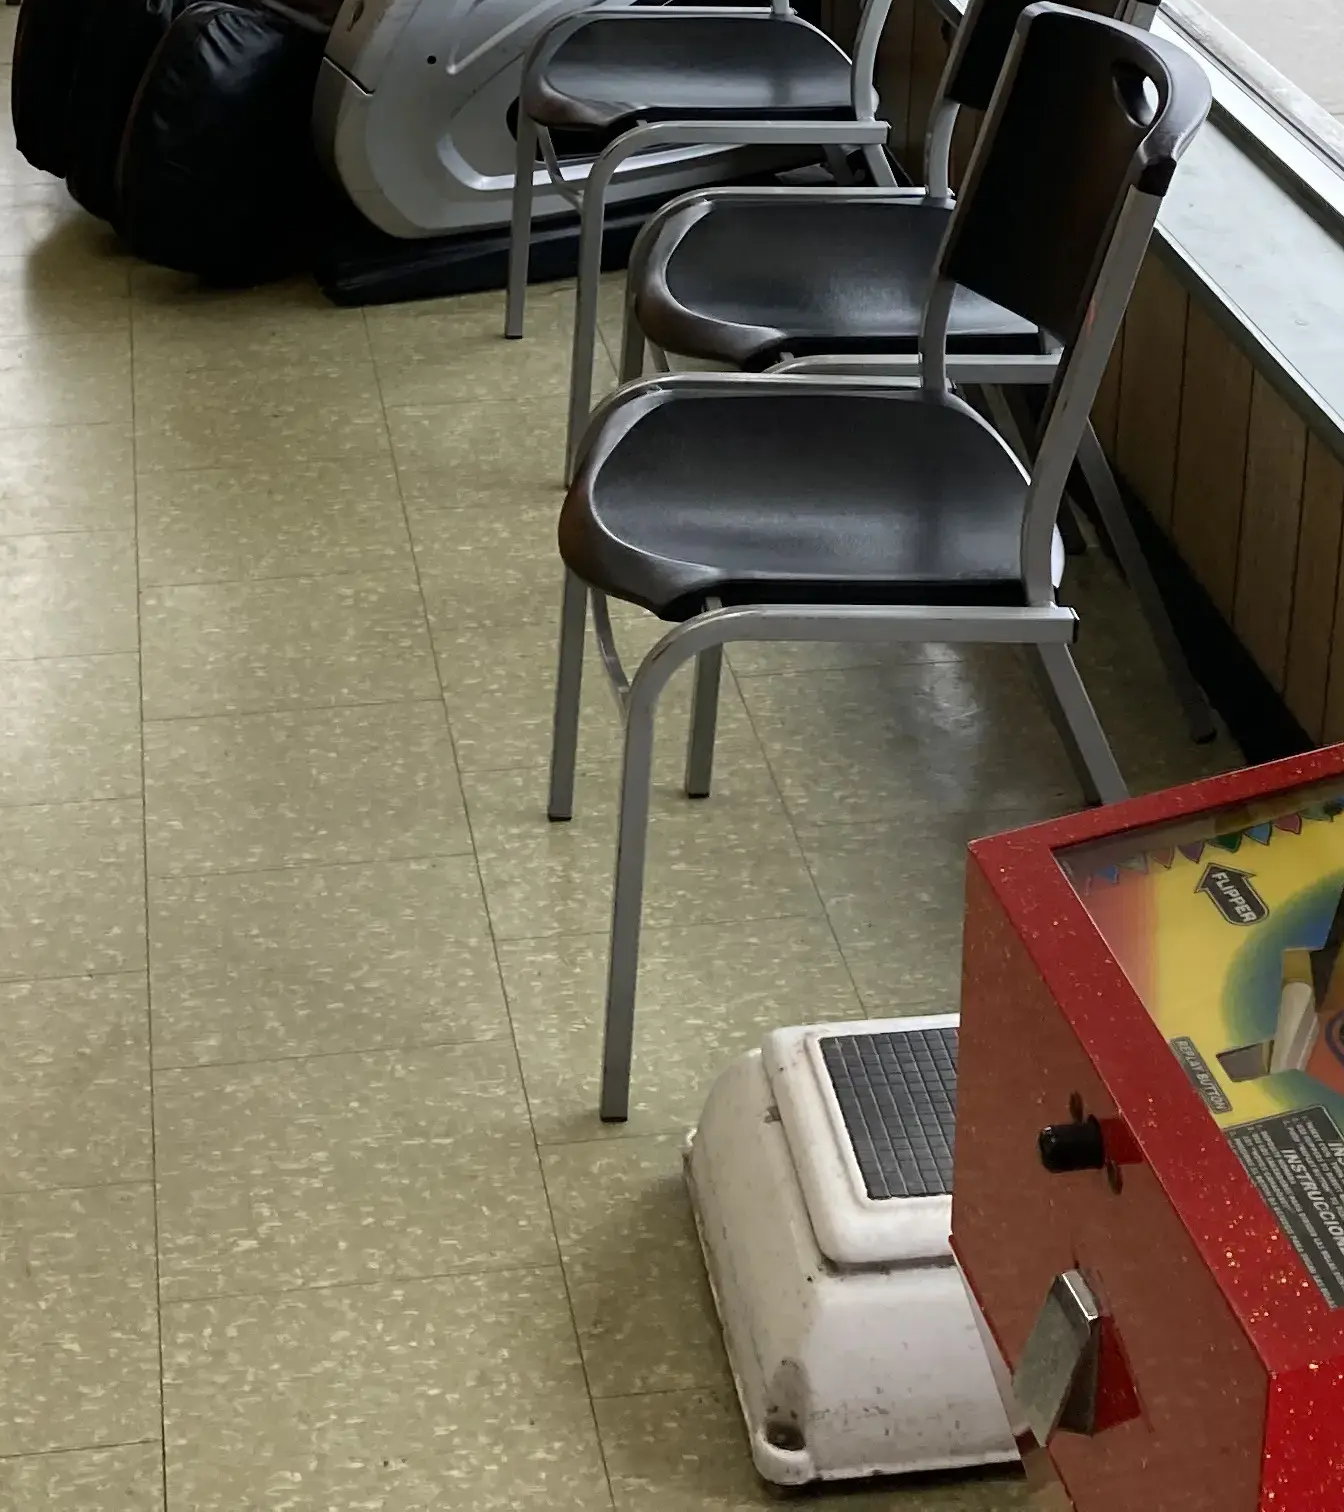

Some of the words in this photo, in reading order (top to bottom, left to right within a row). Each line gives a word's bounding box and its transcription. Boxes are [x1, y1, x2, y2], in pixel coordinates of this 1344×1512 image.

[1210, 870, 1257, 925] FLIPPER
[1176, 1040, 1201, 1075] REPLAY
[1196, 1068, 1227, 1111] BUTTON
